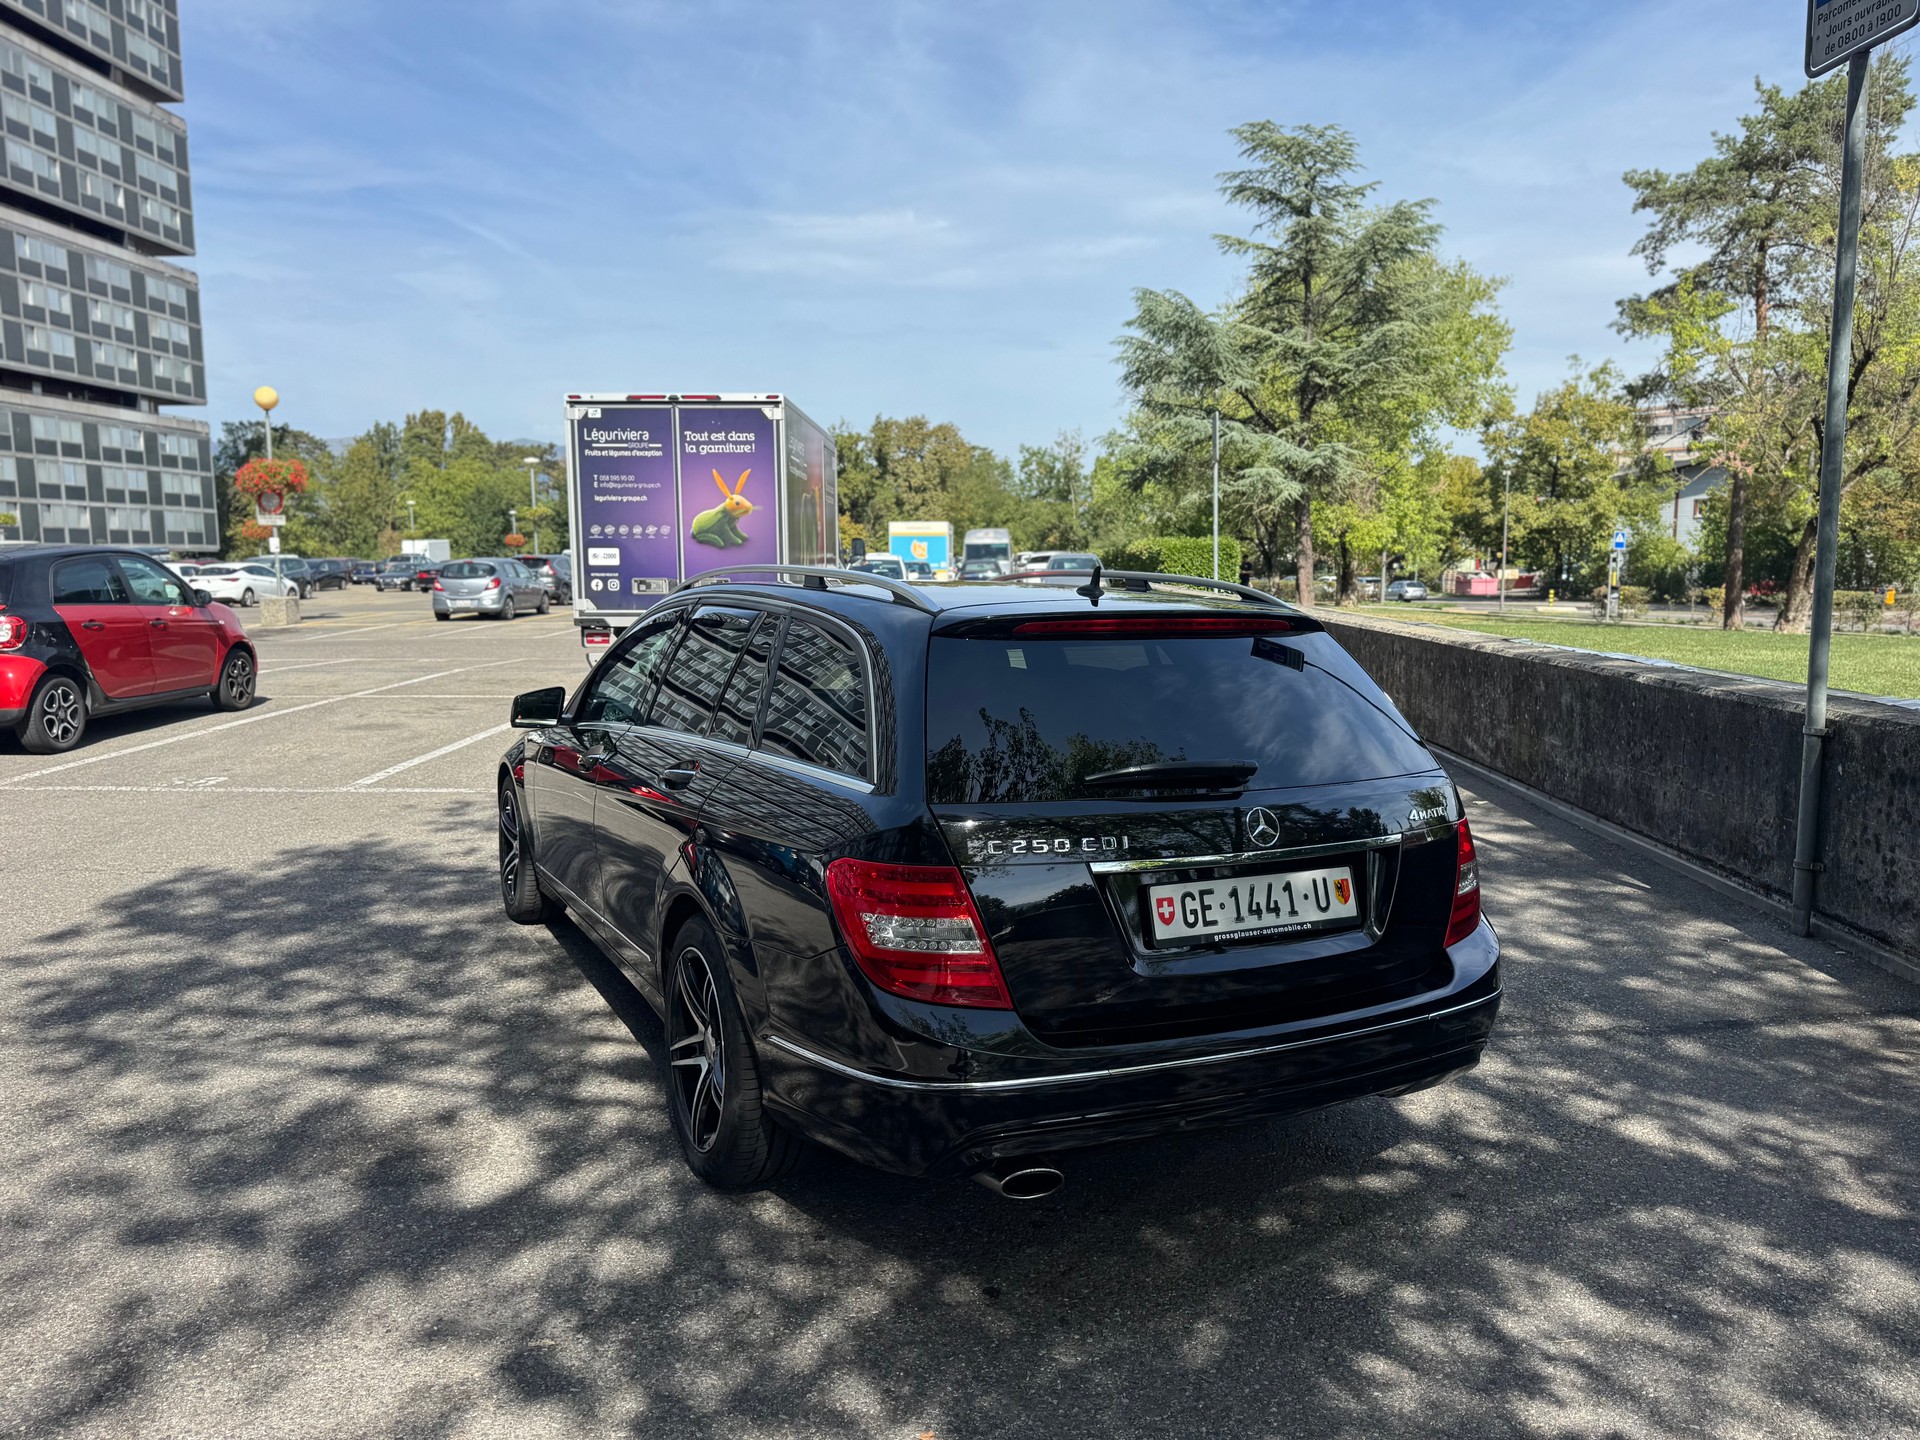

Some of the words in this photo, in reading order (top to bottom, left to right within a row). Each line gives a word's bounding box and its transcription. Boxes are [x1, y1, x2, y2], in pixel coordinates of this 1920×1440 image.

[1826, 16, 1852, 38] Jours
[1824, 42, 1836, 56] de
[1867, 21, 1874, 32] à
[583, 427, 650, 443] Léguriviera
[684, 431, 709, 441] Tout
[710, 431, 726, 441] est
[727, 431, 756, 441] dans
[584, 449, 601, 457] Fruits
[609, 449, 631, 458] légumes
[631, 449, 663, 458] d'exception
[684, 443, 697, 453] la
[987, 840, 1004, 855] C
[1011, 838, 1071, 855] 250
[1081, 835, 1129, 852] CDI
[1214, 922, 1312, 942] grossglauser-automobile.ch
